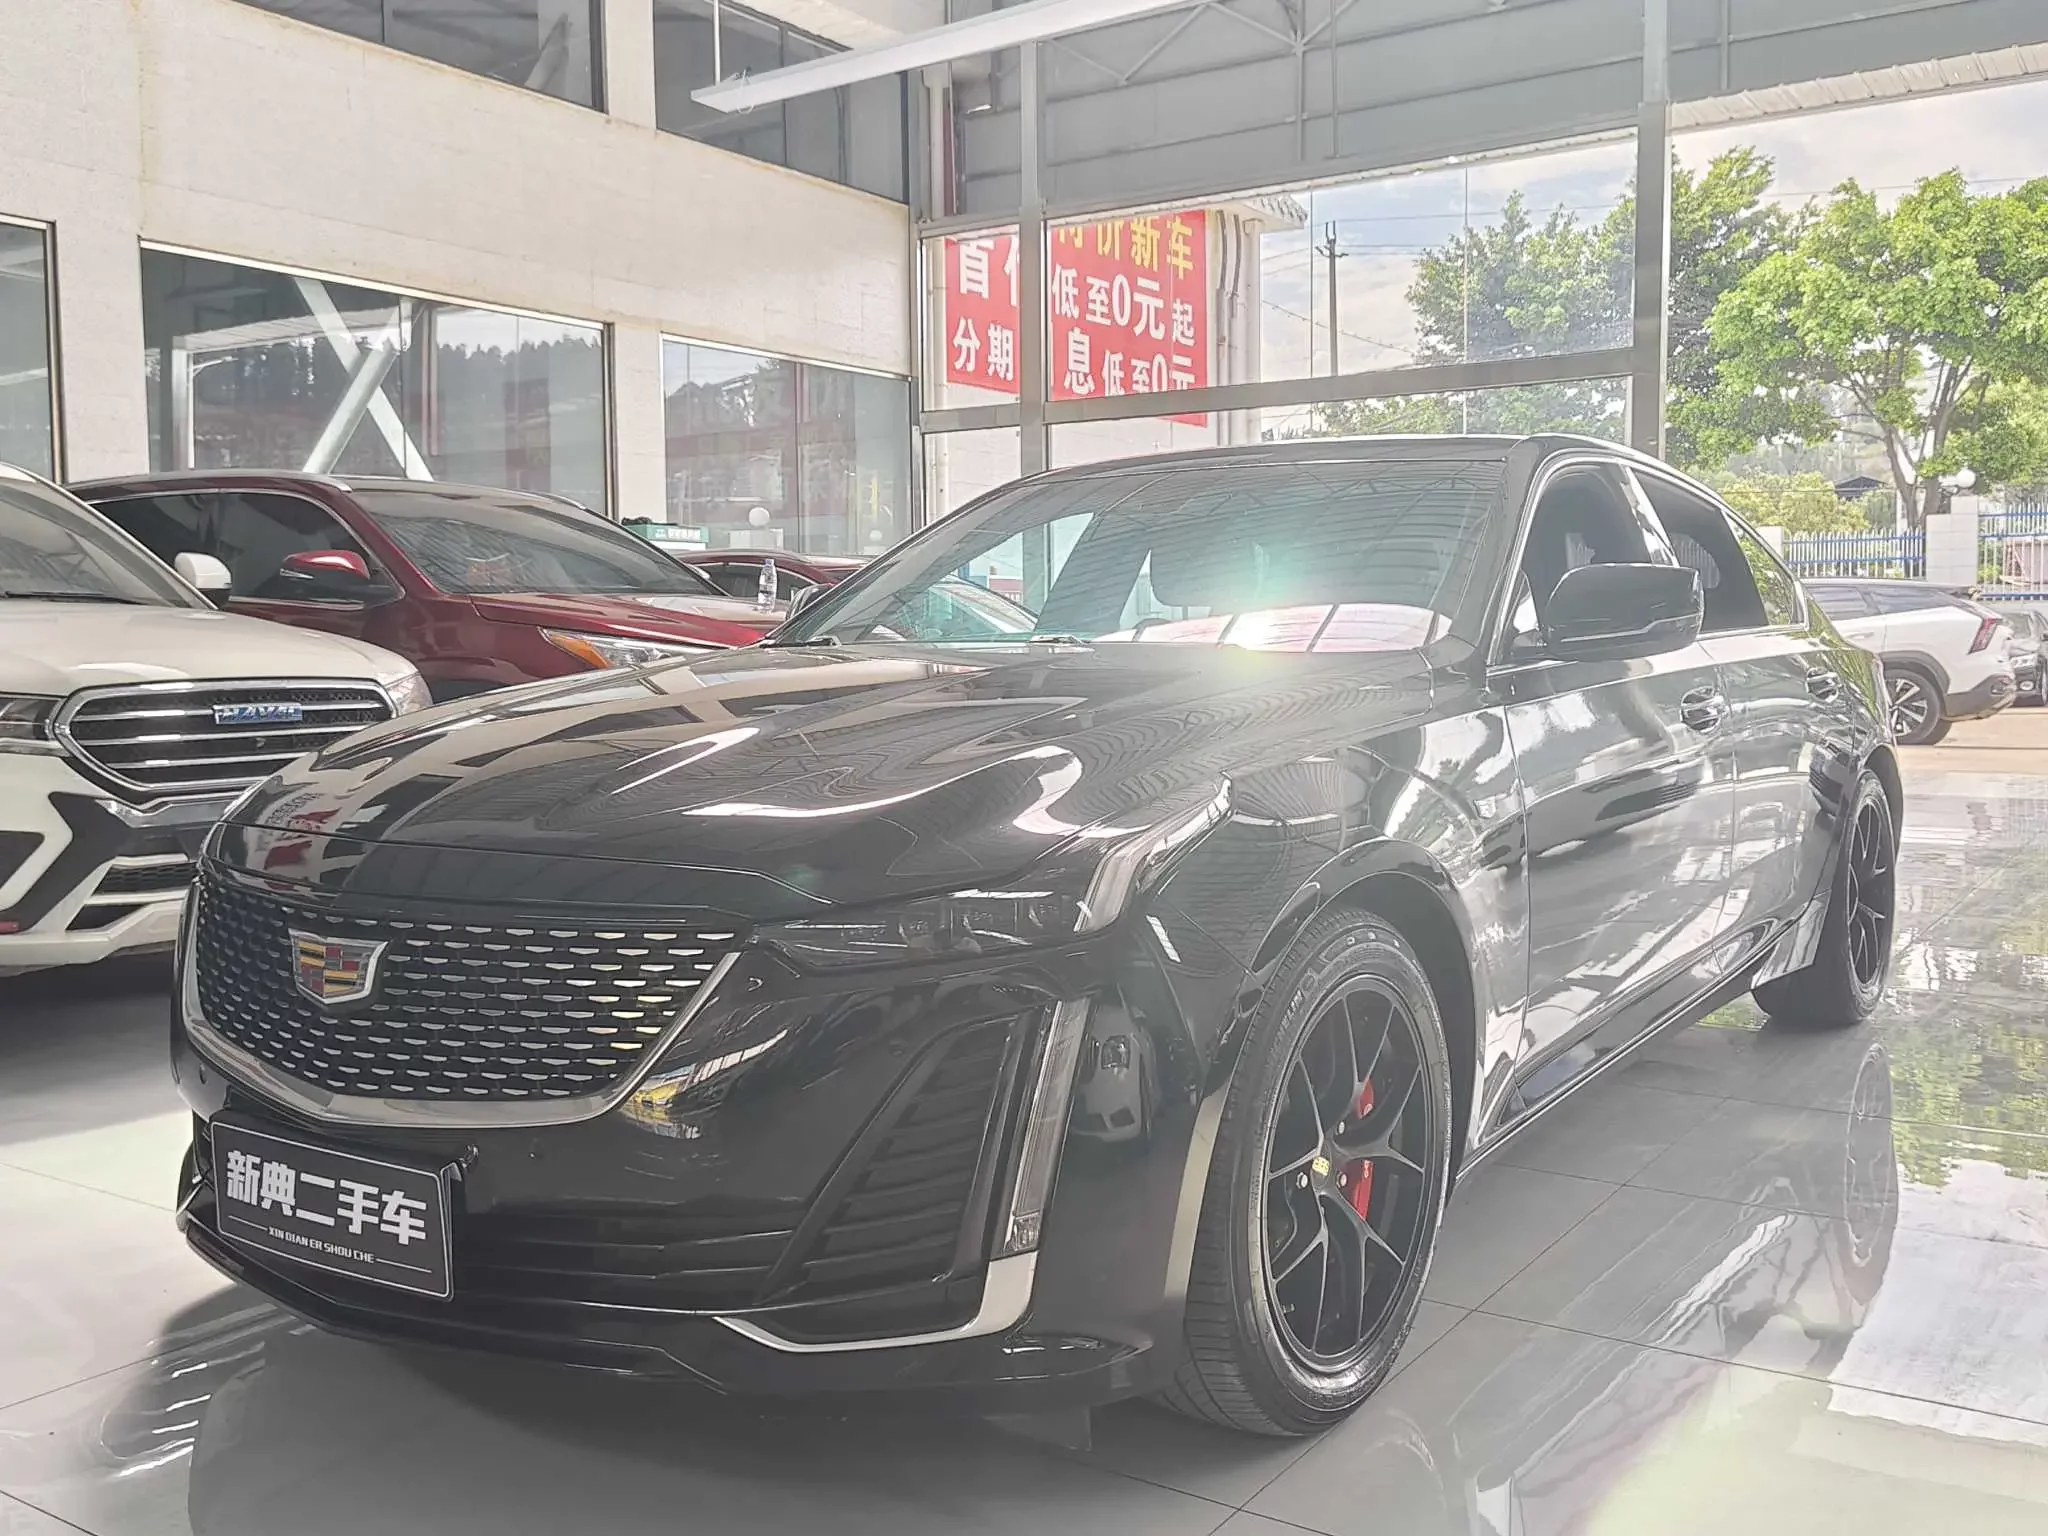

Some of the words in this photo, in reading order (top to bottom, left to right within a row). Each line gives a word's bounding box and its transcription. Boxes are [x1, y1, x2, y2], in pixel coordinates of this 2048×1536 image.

[226, 1150, 428, 1246] 新典二手车
[268, 1226, 285, 1240] XIN
[285, 1231, 309, 1247] DIAN
[309, 1239, 323, 1251] ER
[323, 1242, 352, 1258] SHOU
[353, 1249, 375, 1264] CHE
